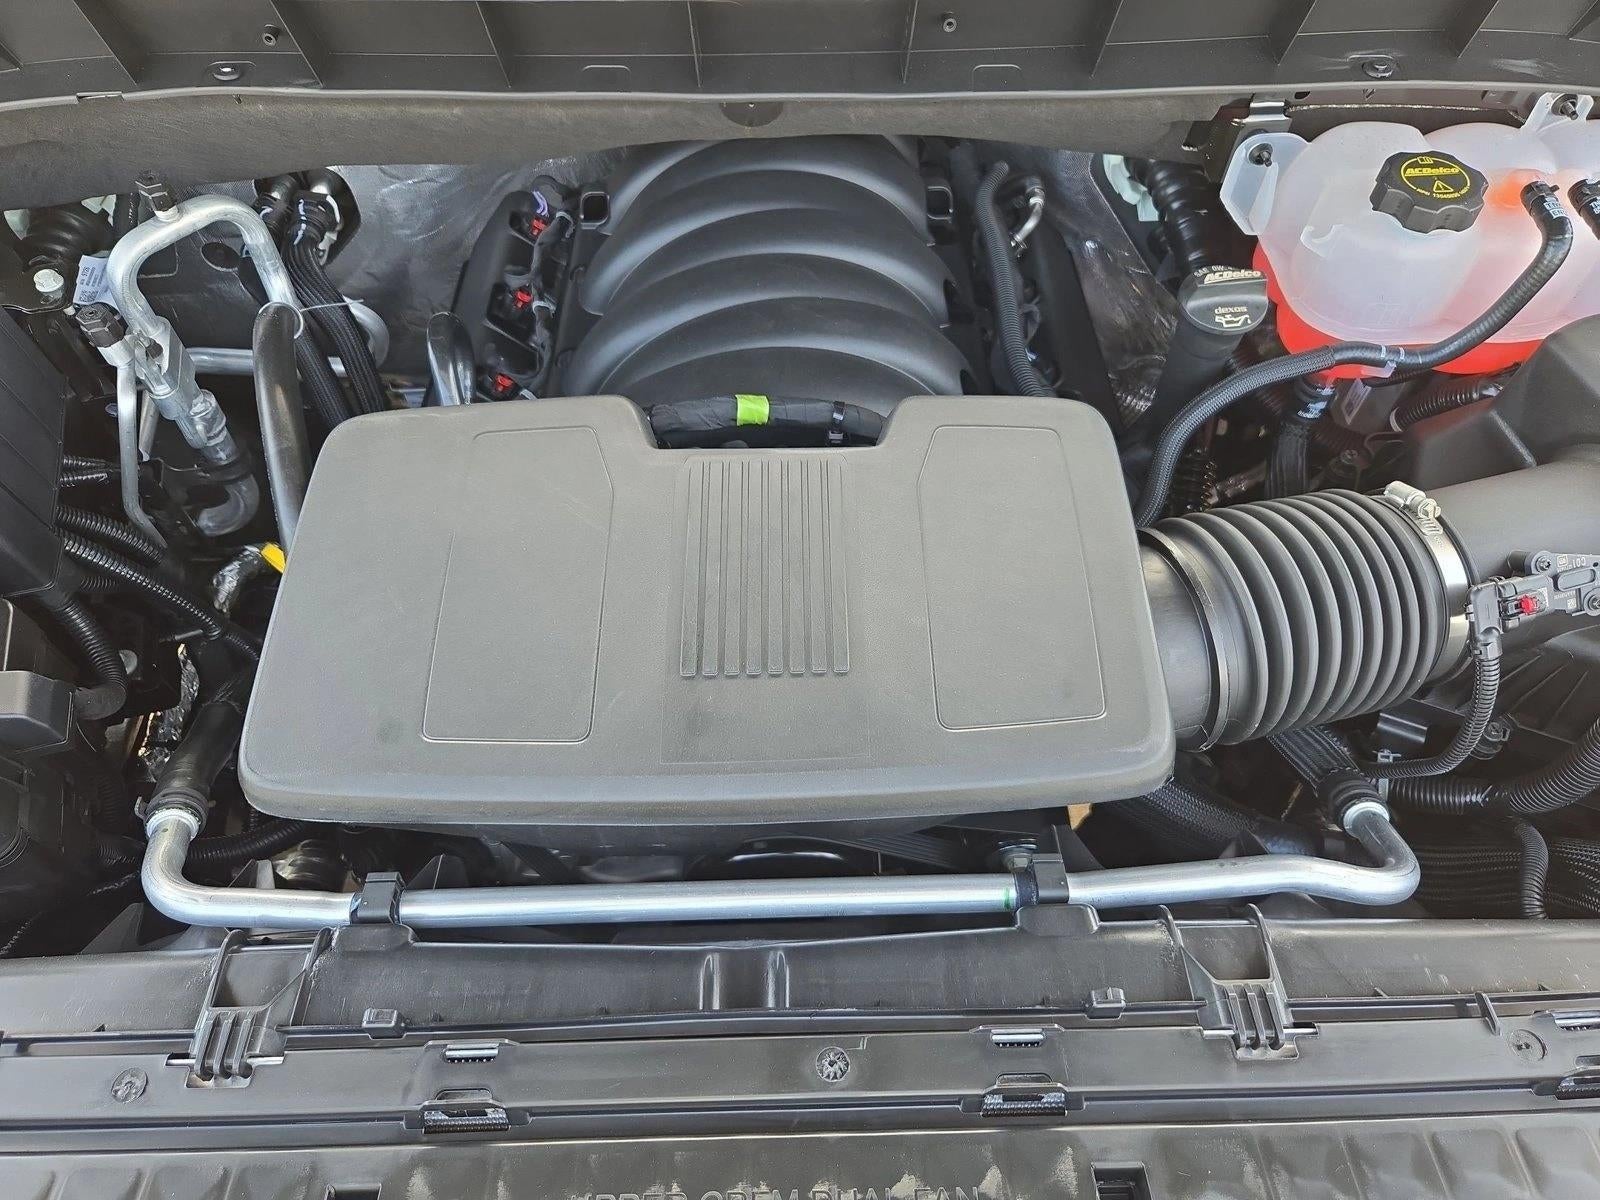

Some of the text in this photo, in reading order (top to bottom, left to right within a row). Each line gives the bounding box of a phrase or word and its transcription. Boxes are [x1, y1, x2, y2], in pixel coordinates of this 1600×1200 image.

[1404, 167, 1460, 177] ACDelco
[1204, 269, 1261, 284] ACDelco
[1214, 306, 1247, 314] dexos
